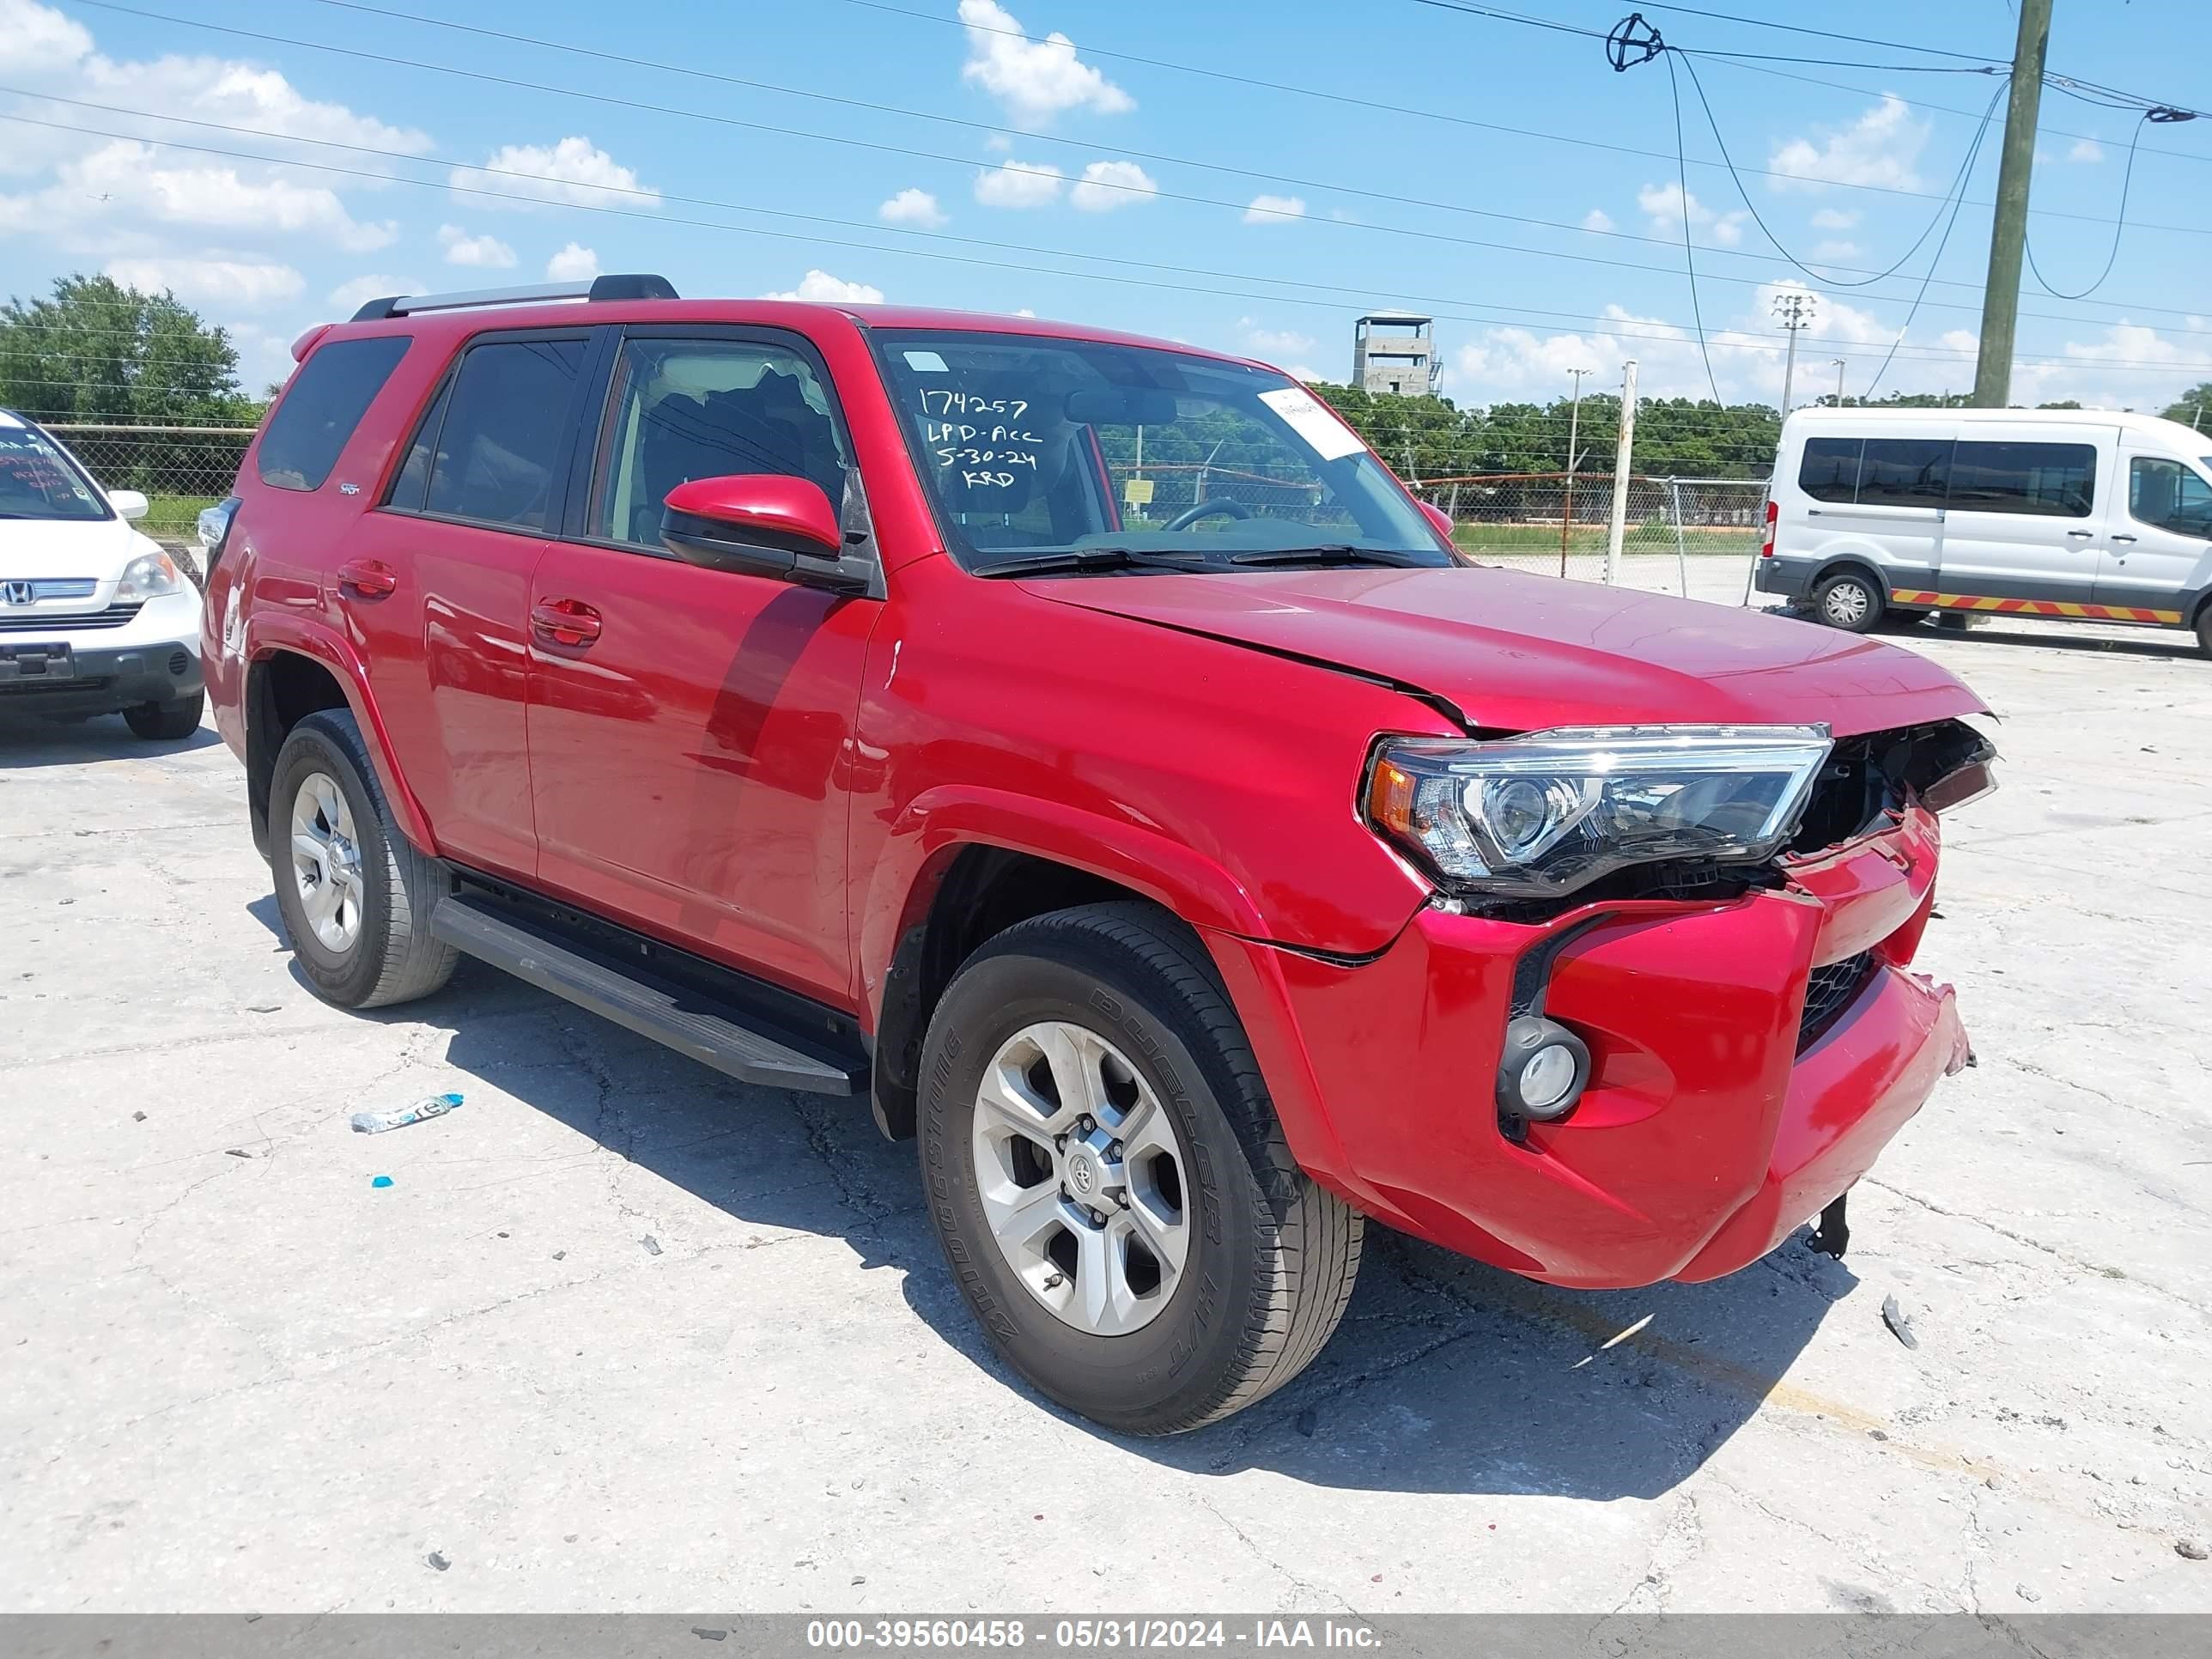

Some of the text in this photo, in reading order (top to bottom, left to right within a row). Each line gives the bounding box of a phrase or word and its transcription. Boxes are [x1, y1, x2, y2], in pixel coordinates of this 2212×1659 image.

[920, 388, 1028, 420] 174257
[936, 447, 1037, 471] 5-30-24
[961, 470, 1015, 489] KRD
[1089, 988, 1223, 1245] DUELER
[915, 1027, 1018, 1346] BRIDGESTONE
